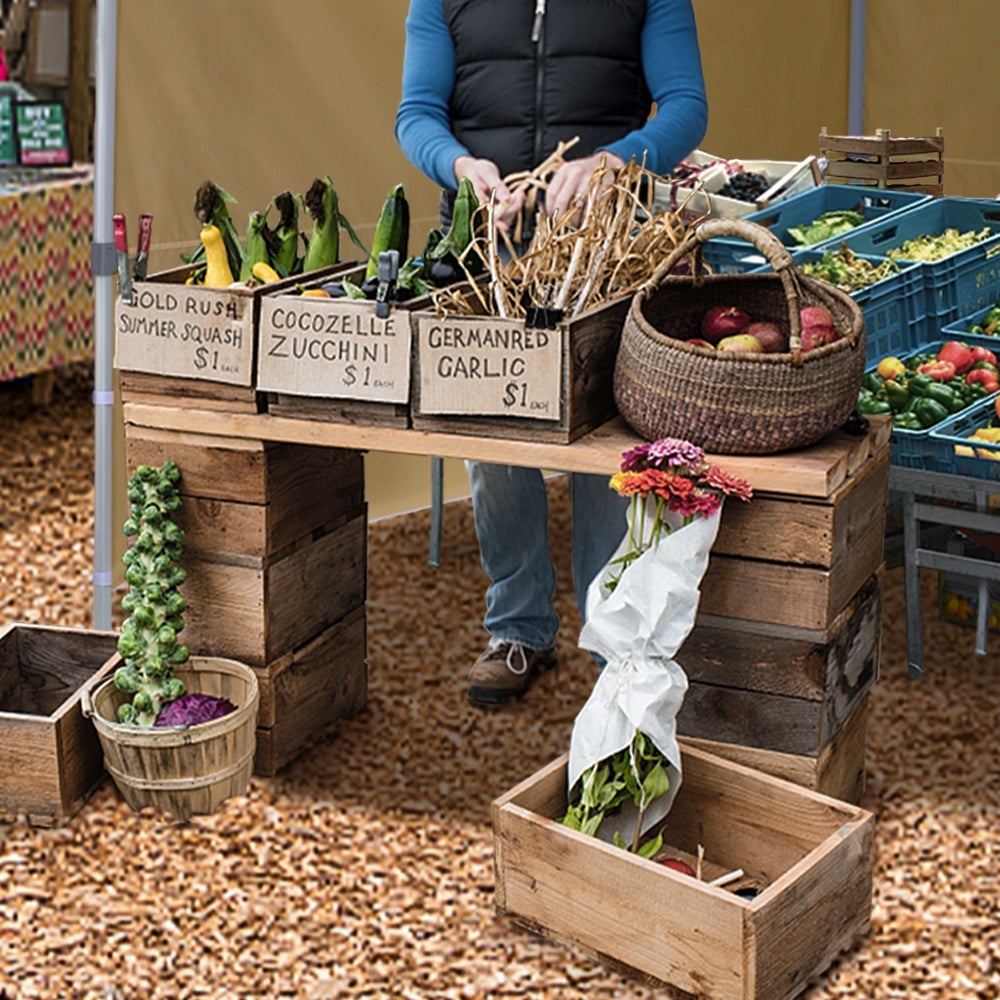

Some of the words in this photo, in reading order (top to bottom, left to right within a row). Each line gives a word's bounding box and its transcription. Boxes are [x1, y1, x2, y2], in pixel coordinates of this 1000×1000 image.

[126, 288, 178, 311] GOLD
[185, 297, 237, 320] RUSH
[119, 313, 178, 339] SUMMER
[181, 322, 243, 349] SQUASH
[271, 308, 397, 337] COCOZELLE
[193, 345, 219, 370] $1
[268, 335, 389, 364] ZUCCHINI
[342, 364, 371, 387] $1
[437, 355, 526, 379] GARLIC
[502, 380, 528, 409] $1
